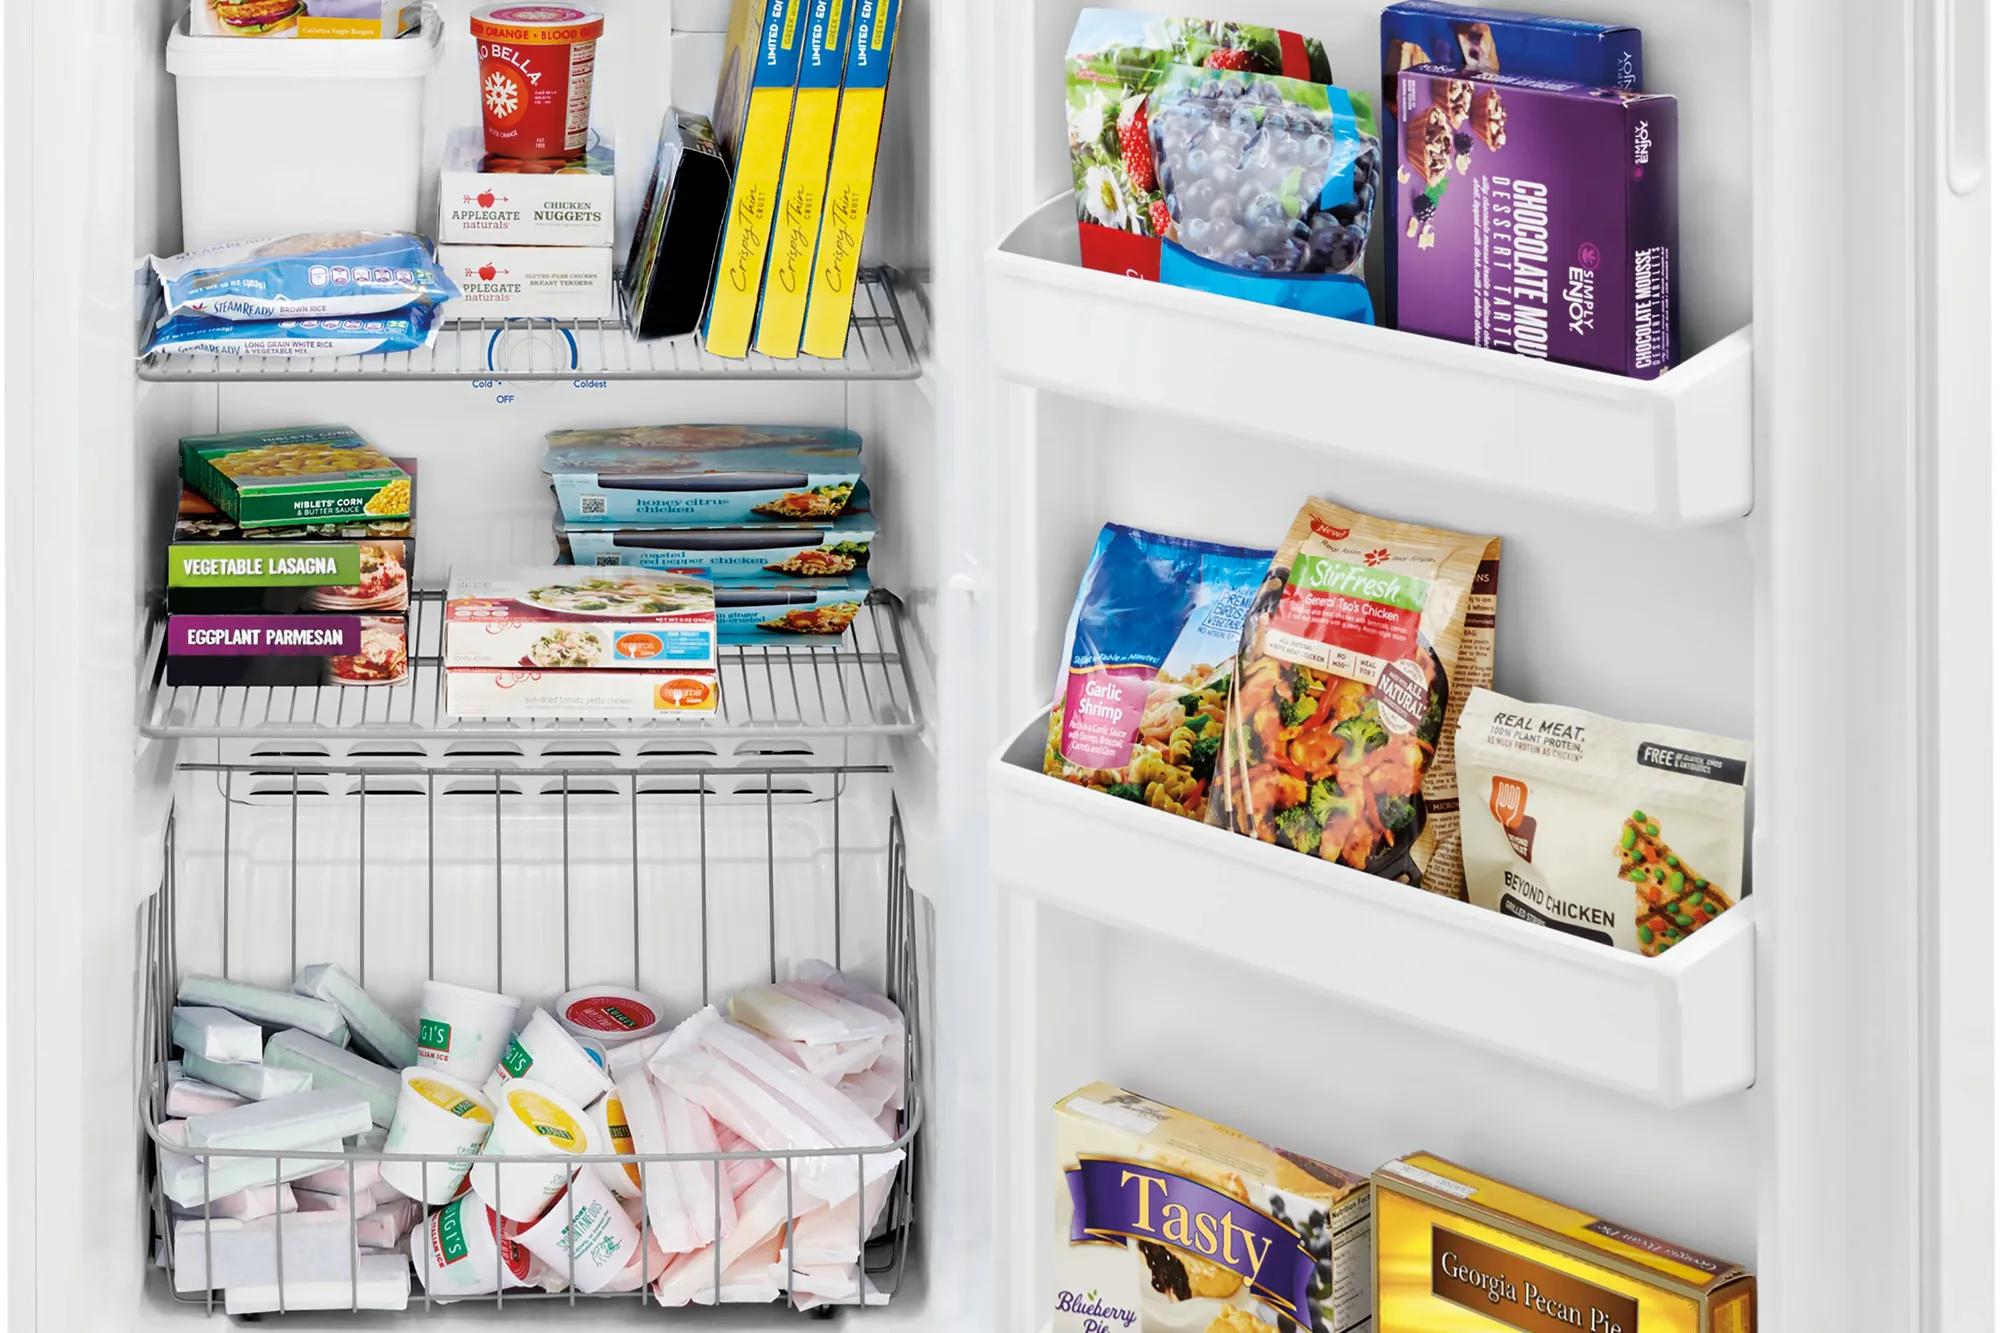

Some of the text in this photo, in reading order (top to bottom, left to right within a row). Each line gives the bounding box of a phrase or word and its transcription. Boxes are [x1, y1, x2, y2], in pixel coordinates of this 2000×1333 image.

[486, 28, 529, 40] ORANGE
[541, 28, 577, 40] BLOOD
[768, 24, 778, 66] LIMITED
[812, 24, 822, 66] LIMITED
[858, 24, 869, 66] LIMITED
[491, 44, 542, 85] BELLA
[1640, 120, 1652, 164] ENJOY
[452, 211, 520, 221] APPLEGATE
[534, 211, 602, 222] NUGGETS
[544, 201, 592, 209] CHICKEN
[756, 192, 766, 219] CRUST
[804, 193, 814, 220] CRUST
[850, 193, 860, 220] CRUST
[463, 221, 509, 229] naturals
[1492, 176, 1511, 271] DESSERT
[730, 184, 760, 292] Crispy Thin
[779, 184, 808, 293] Crispy Thin
[825, 185, 855, 292] Crispy Thin
[1512, 179, 1548, 304] CHOCOLATE
[463, 284, 521, 293] PPLEGATE
[1562, 266, 1584, 336] ENJOY
[1583, 270, 1594, 329] SIMPLY
[1635, 248, 1651, 369] CHOCOLATE MOUSSE
[1652, 246, 1661, 366] DESSERT TARTLETS
[472, 380, 607, 388] Cold Coldest
[496, 395, 514, 403] OFF
[304, 508, 333, 516] BUTTER
[337, 498, 363, 506] CORN
[637, 498, 730, 506] honey citrus
[1317, 524, 1347, 537] New!
[184, 557, 337, 576] VEGETABLE LASAGNA
[1310, 560, 1400, 603] StirFresh
[1305, 593, 1399, 622] General Tso's Chicken
[187, 629, 343, 645] EGGPLANT PARMESAN
[1099, 653, 1160, 664] Table Minutes!
[1086, 681, 1122, 701] Garlic
[1378, 674, 1423, 719] NATURAL
[1406, 682, 1422, 700] ALL
[1078, 698, 1123, 725] Shrimp
[1490, 726, 1584, 753] 100% PLANT PROTEIN.
[1494, 712, 1585, 742] REAL MEAT.
[1644, 746, 1674, 767] FREE
[1504, 870, 1615, 929] BEYOND CHICKEN
[422, 1025, 444, 1044] GI'S
[1120, 1170, 1273, 1287] Tasty
[1441, 1251, 1622, 1333] Georgia Pecan Pie
[1055, 1290, 1137, 1328] Blueberry
